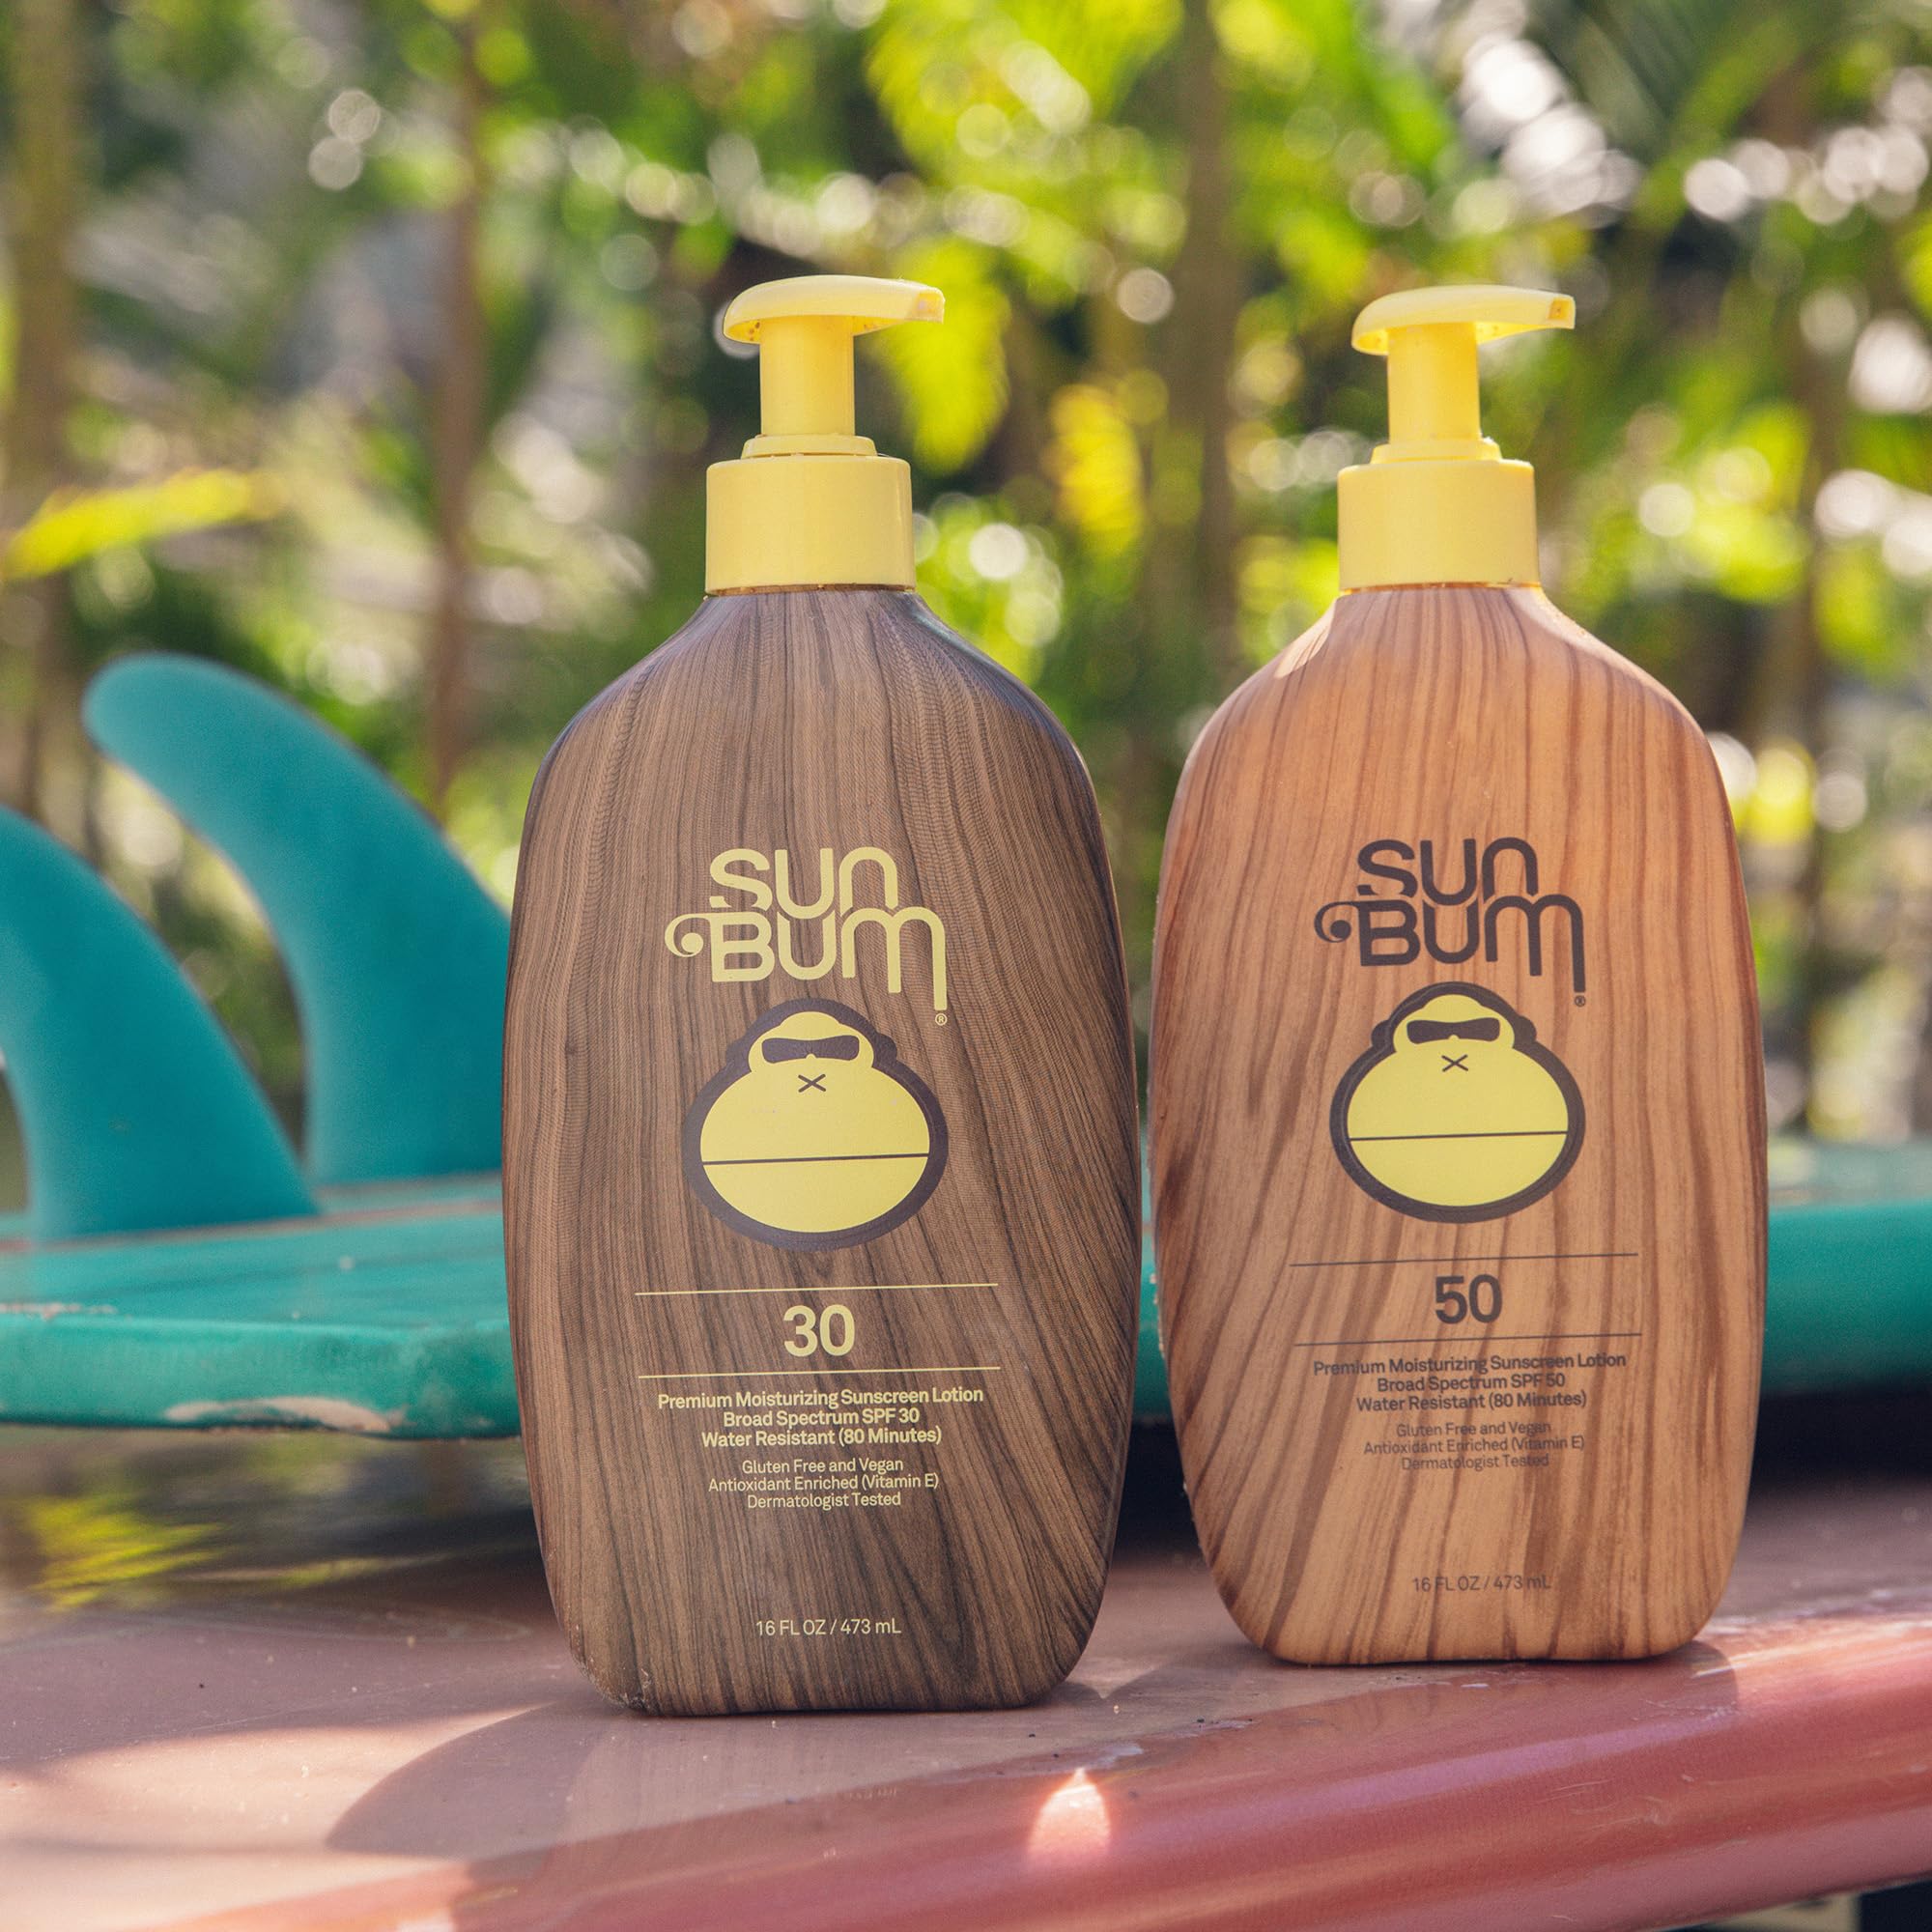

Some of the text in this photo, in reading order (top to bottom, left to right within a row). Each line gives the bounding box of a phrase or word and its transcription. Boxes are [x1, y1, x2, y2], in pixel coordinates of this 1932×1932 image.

[1435, 1274, 1502, 1324] 50
[783, 1304, 855, 1357] 30
[1314, 1353, 1626, 1376] Premium Moisturizing Sunscreen Lotion
[1378, 1374, 1565, 1393] Broad Spectrum SPF 50
[658, 1386, 983, 1409] Premium Moisturizing Sunscreen Lotion
[1357, 1390, 1586, 1411] Water Resistant (80 Minutes)
[724, 1407, 919, 1429] Broad Spectrum SPF 30
[702, 1426, 942, 1447] Water Resistant (80 Minutes)
[1397, 1421, 1551, 1437] Gluten Free and Vegan
[1364, 1435, 1585, 1456] Antioxidant Enriched (Vitamin E)
[742, 1458, 903, 1474] Gluten Free and Vegan
[1402, 1454, 1548, 1471] Dermatologist Tested
[709, 1472, 939, 1492] Antioxidant Enriched (Vitamin E)
[748, 1492, 900, 1510] Dermatologist Tested
[1412, 1577, 1431, 1592] 16
[1435, 1577, 1456, 1592] FL
[1458, 1577, 1480, 1591] OZ
[1493, 1576, 1523, 1590] 473
[1527, 1575, 1551, 1590] mL
[756, 1620, 775, 1635] 16
[780, 1620, 800, 1635] FL
[803, 1619, 826, 1635] OZ
[840, 1619, 870, 1634] 473
[875, 1618, 901, 1634] mL
